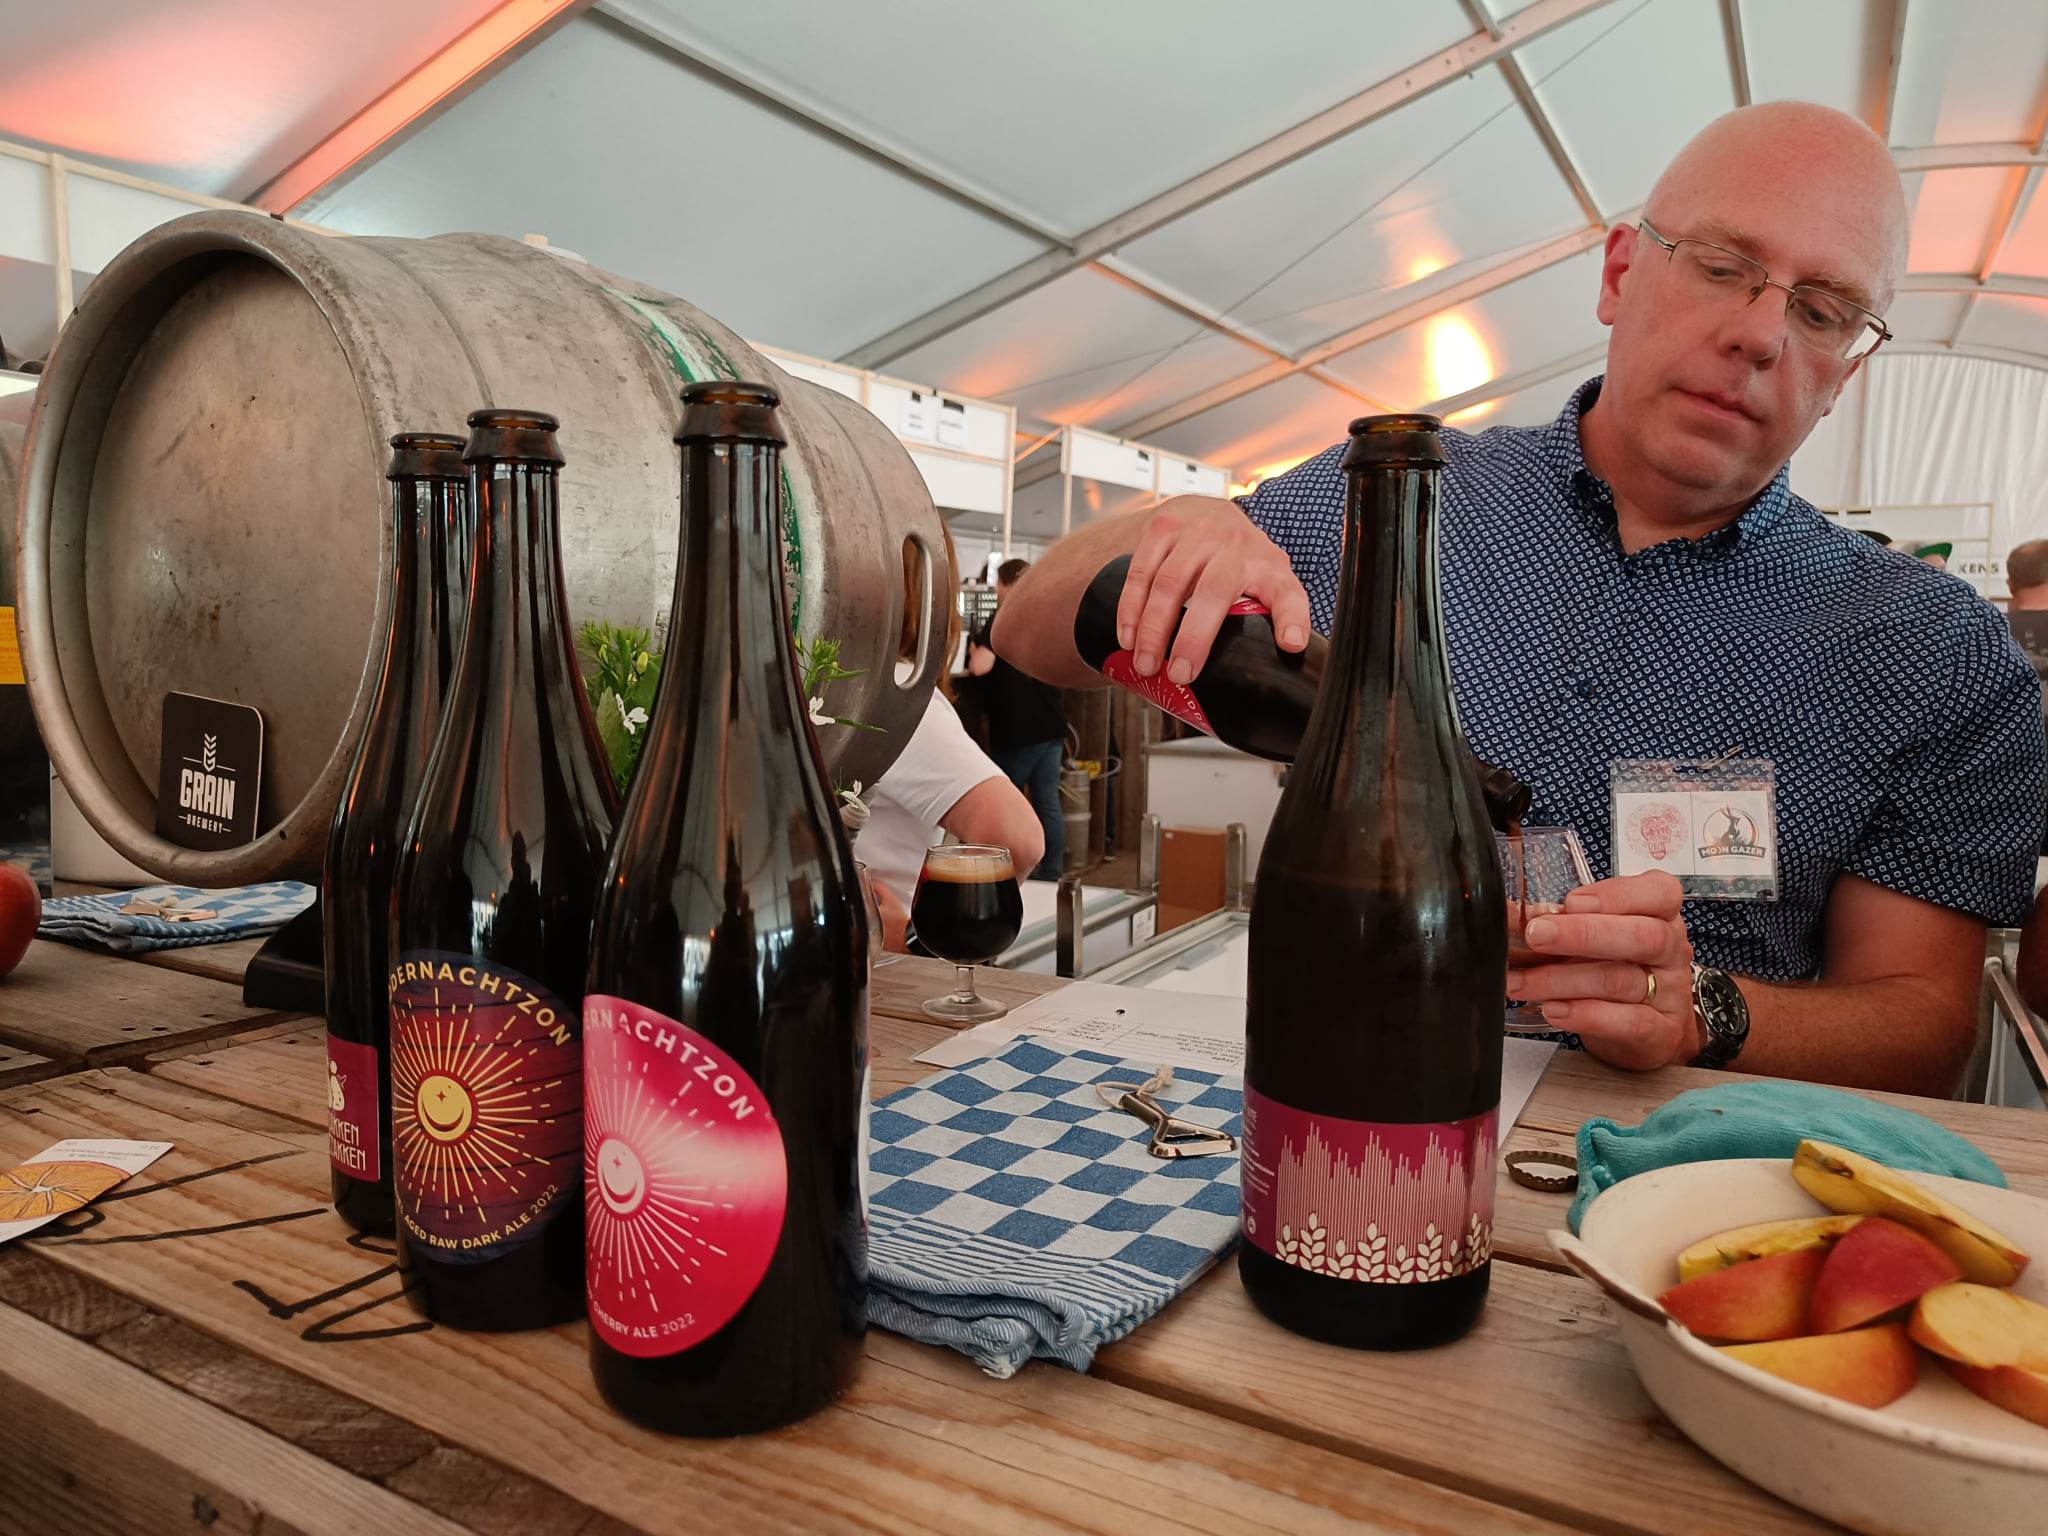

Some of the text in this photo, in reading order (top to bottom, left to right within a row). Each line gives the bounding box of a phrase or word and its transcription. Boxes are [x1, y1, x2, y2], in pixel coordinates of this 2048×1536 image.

[180, 768, 236, 820] GRAIN
[186, 813, 223, 834] BREWERY
[1731, 845, 1765, 856] GAZER
[389, 961, 572, 1047] DERNACHTZON
[404, 1184, 559, 1250] AGED RAW DARK ALE 2022
[593, 1301, 696, 1339] CHERRY ALE 2022
